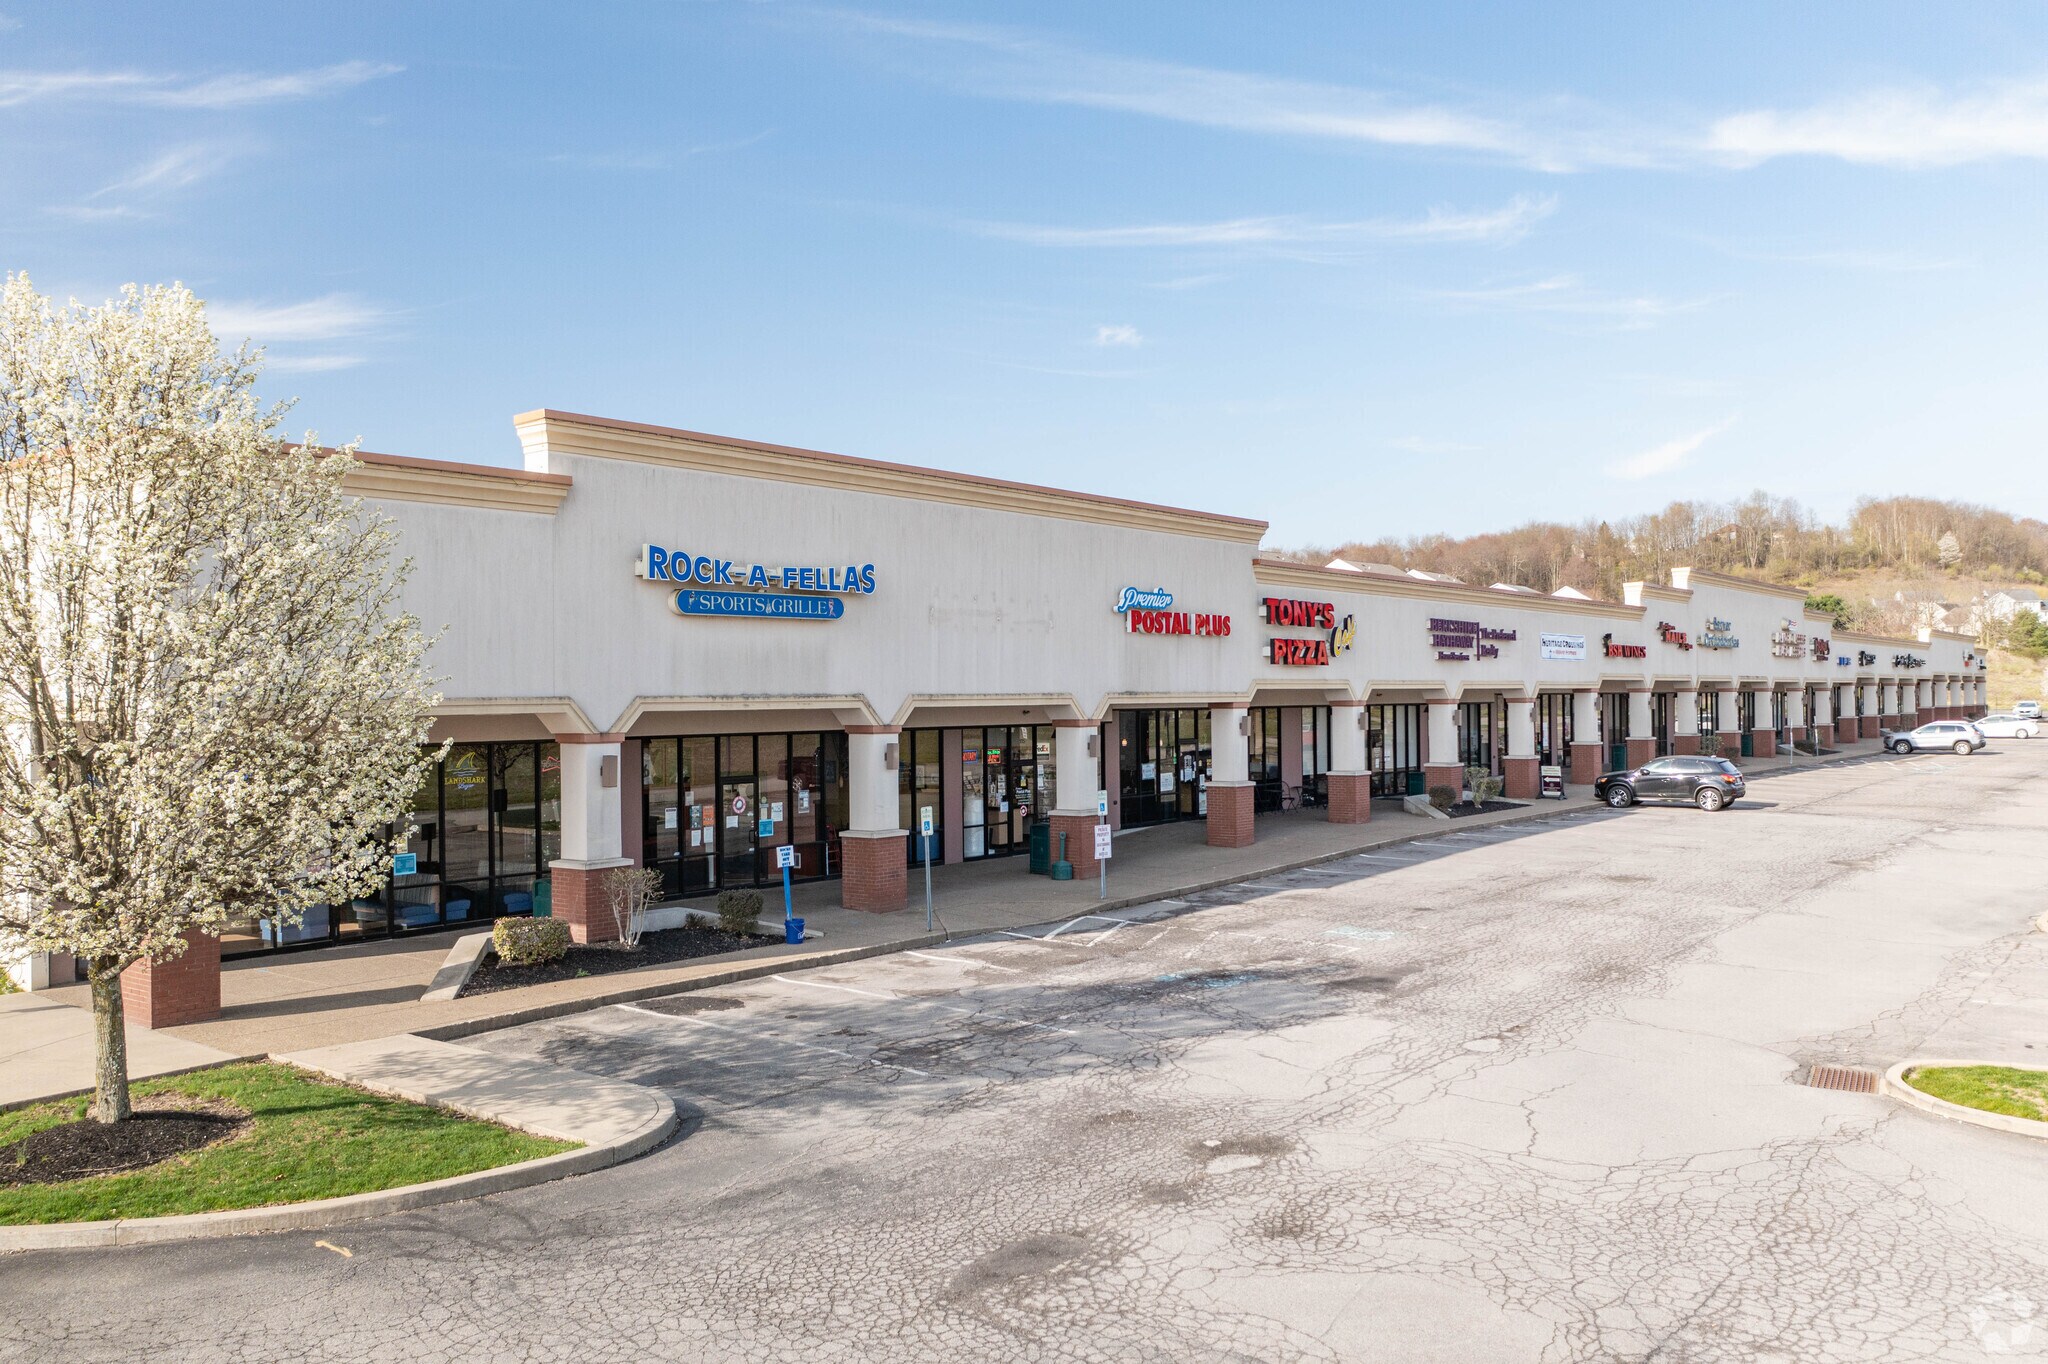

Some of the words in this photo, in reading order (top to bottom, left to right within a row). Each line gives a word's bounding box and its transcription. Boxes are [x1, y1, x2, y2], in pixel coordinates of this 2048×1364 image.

[648, 544, 876, 595] ROCK-A-FELLAS
[699, 595, 766, 612] SPORTS
[771, 598, 828, 616] GRILLE
[1115, 586, 1173, 613] Premier
[1264, 597, 1335, 629] TONY'S
[1130, 609, 1191, 634] POSTAL
[1196, 613, 1231, 636] PLUS
[1433, 634, 1474, 648] HATHAWAY
[1665, 631, 1687, 643] NAILS
[1271, 638, 1329, 665] PIZZA
[444, 776, 485, 785] LANDSHARK
